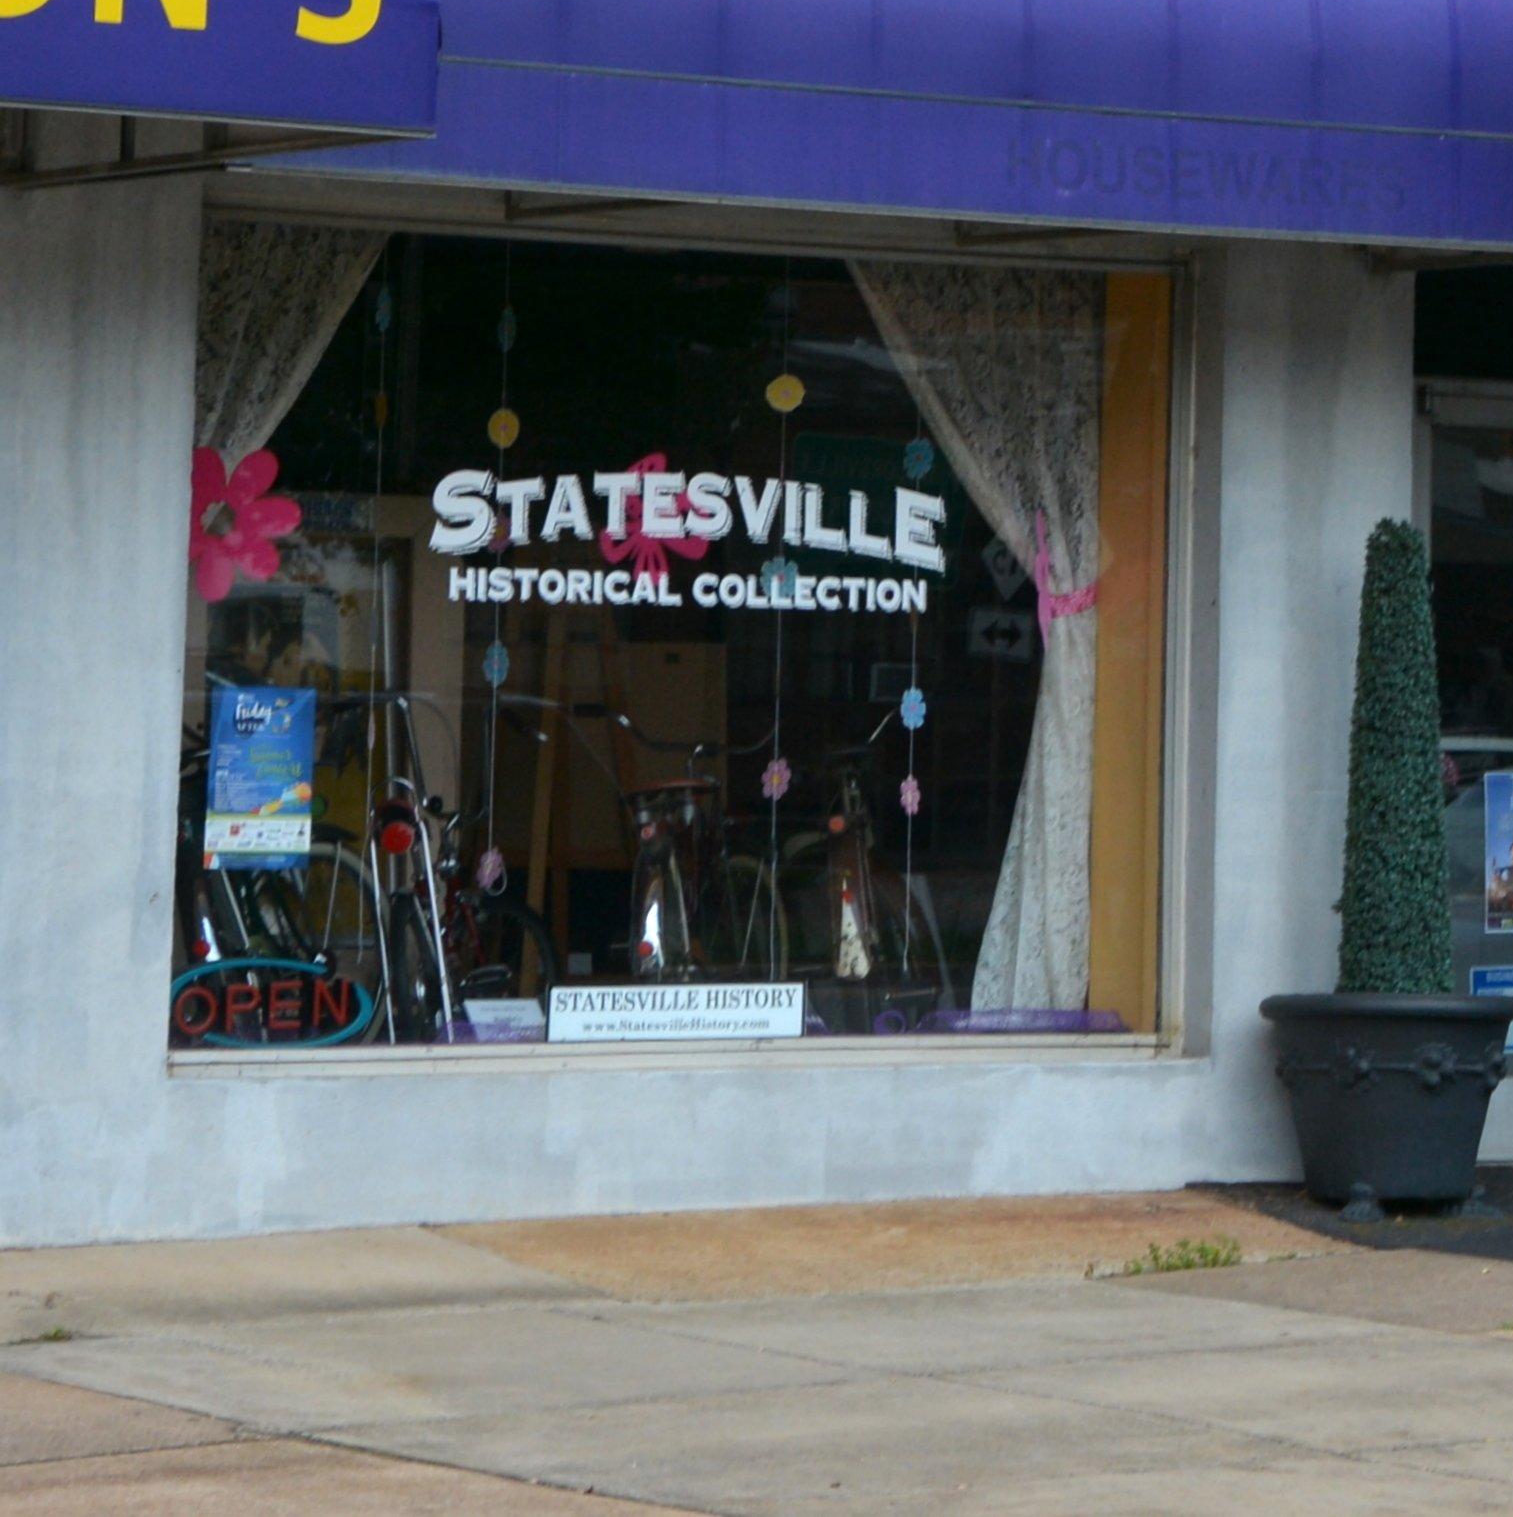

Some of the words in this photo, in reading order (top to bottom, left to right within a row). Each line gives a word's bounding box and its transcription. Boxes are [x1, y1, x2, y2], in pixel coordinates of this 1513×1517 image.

[447, 566, 682, 608] HISTORICAL
[691, 571, 929, 614] COLLECTION
[175, 976, 351, 1035] OPEN
[555, 990, 700, 1013] STATESVILLE
[706, 987, 797, 1010] HISTORY
